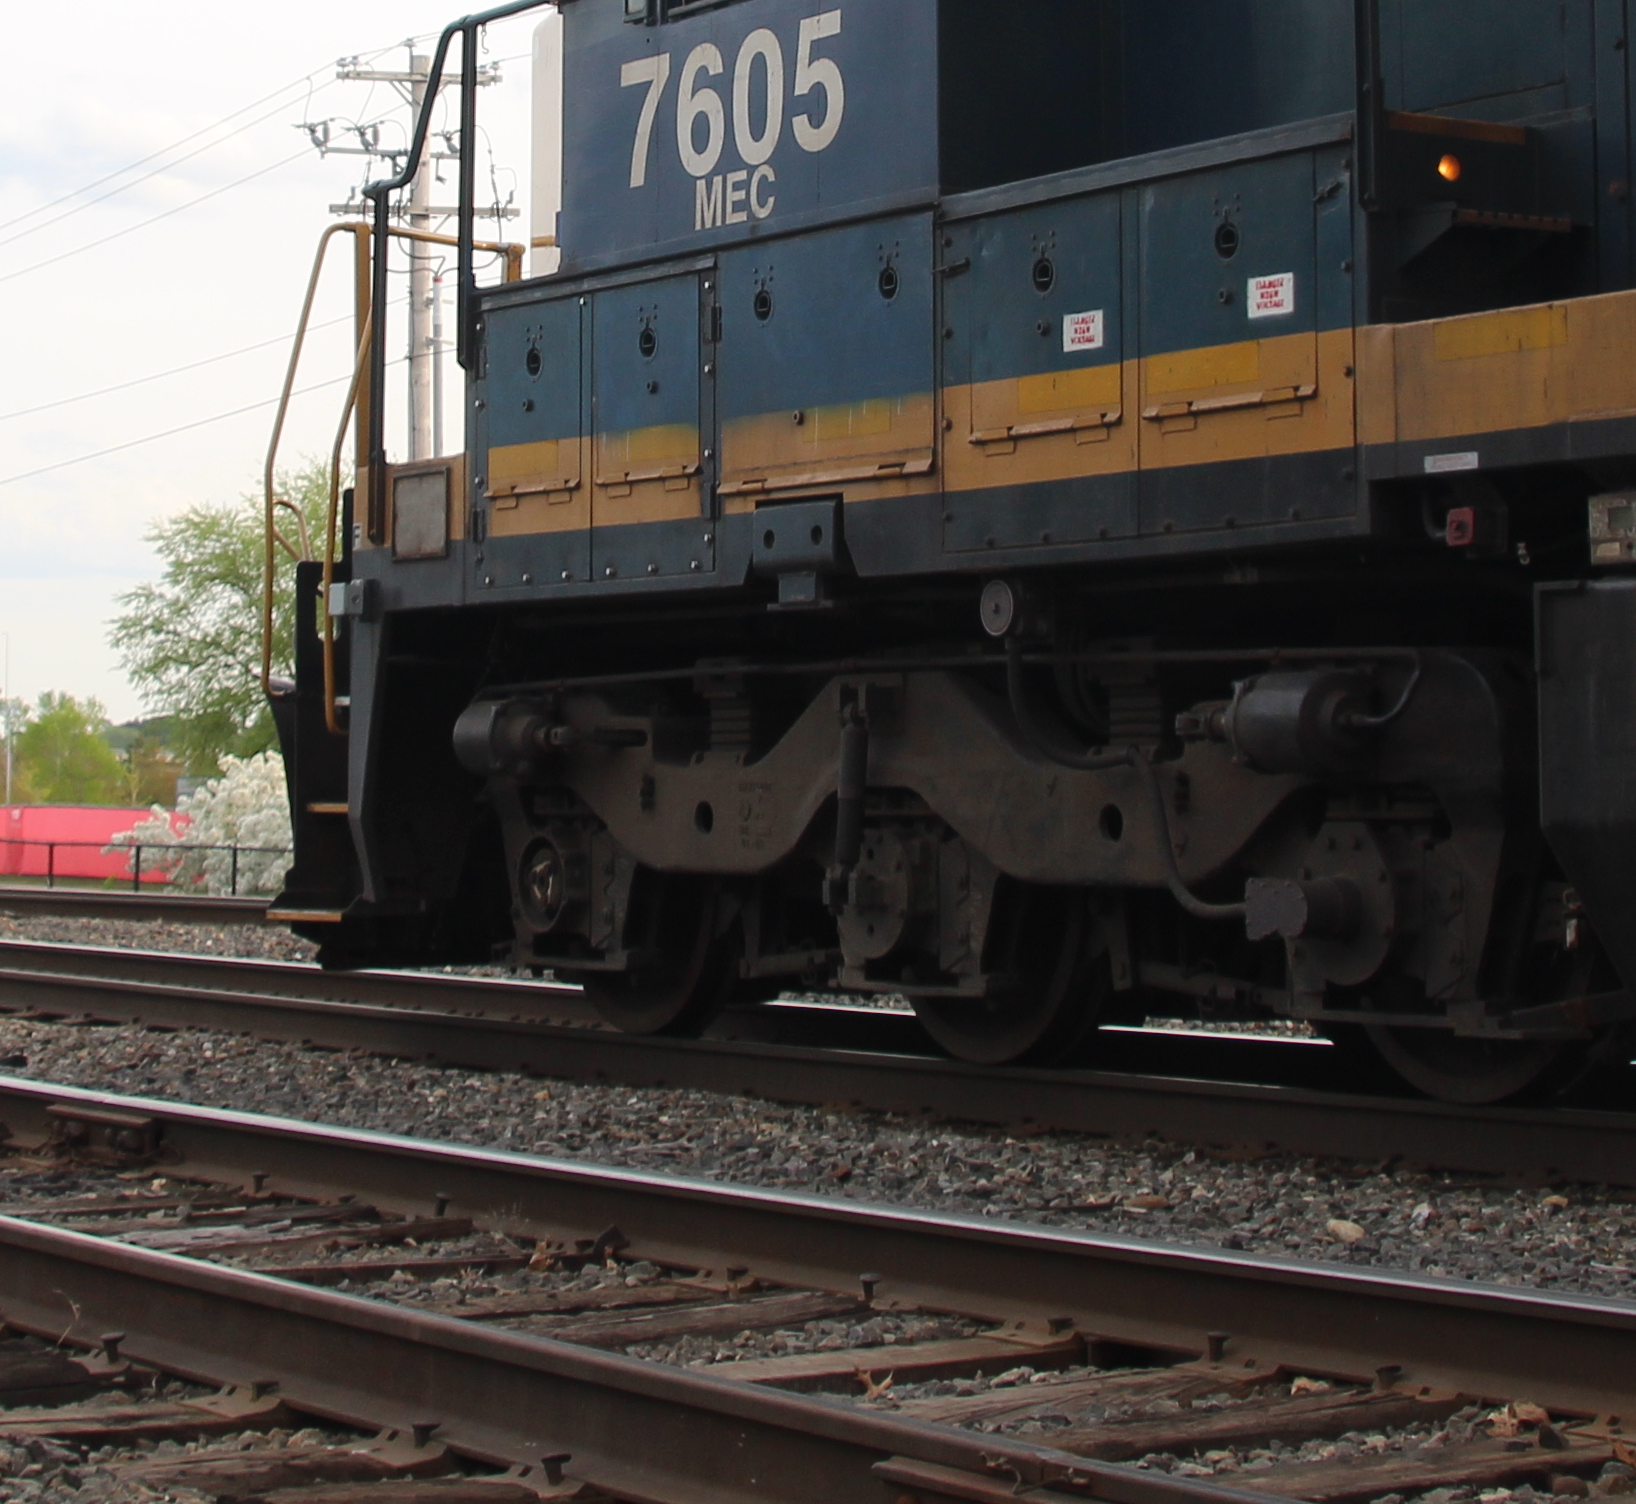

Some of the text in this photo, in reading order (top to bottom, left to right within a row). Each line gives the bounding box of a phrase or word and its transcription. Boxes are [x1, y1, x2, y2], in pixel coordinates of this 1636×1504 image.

[620, 8, 845, 189] 7605
[695, 163, 776, 231] MEC
[1256, 299, 1284, 311] VOLTAGE
